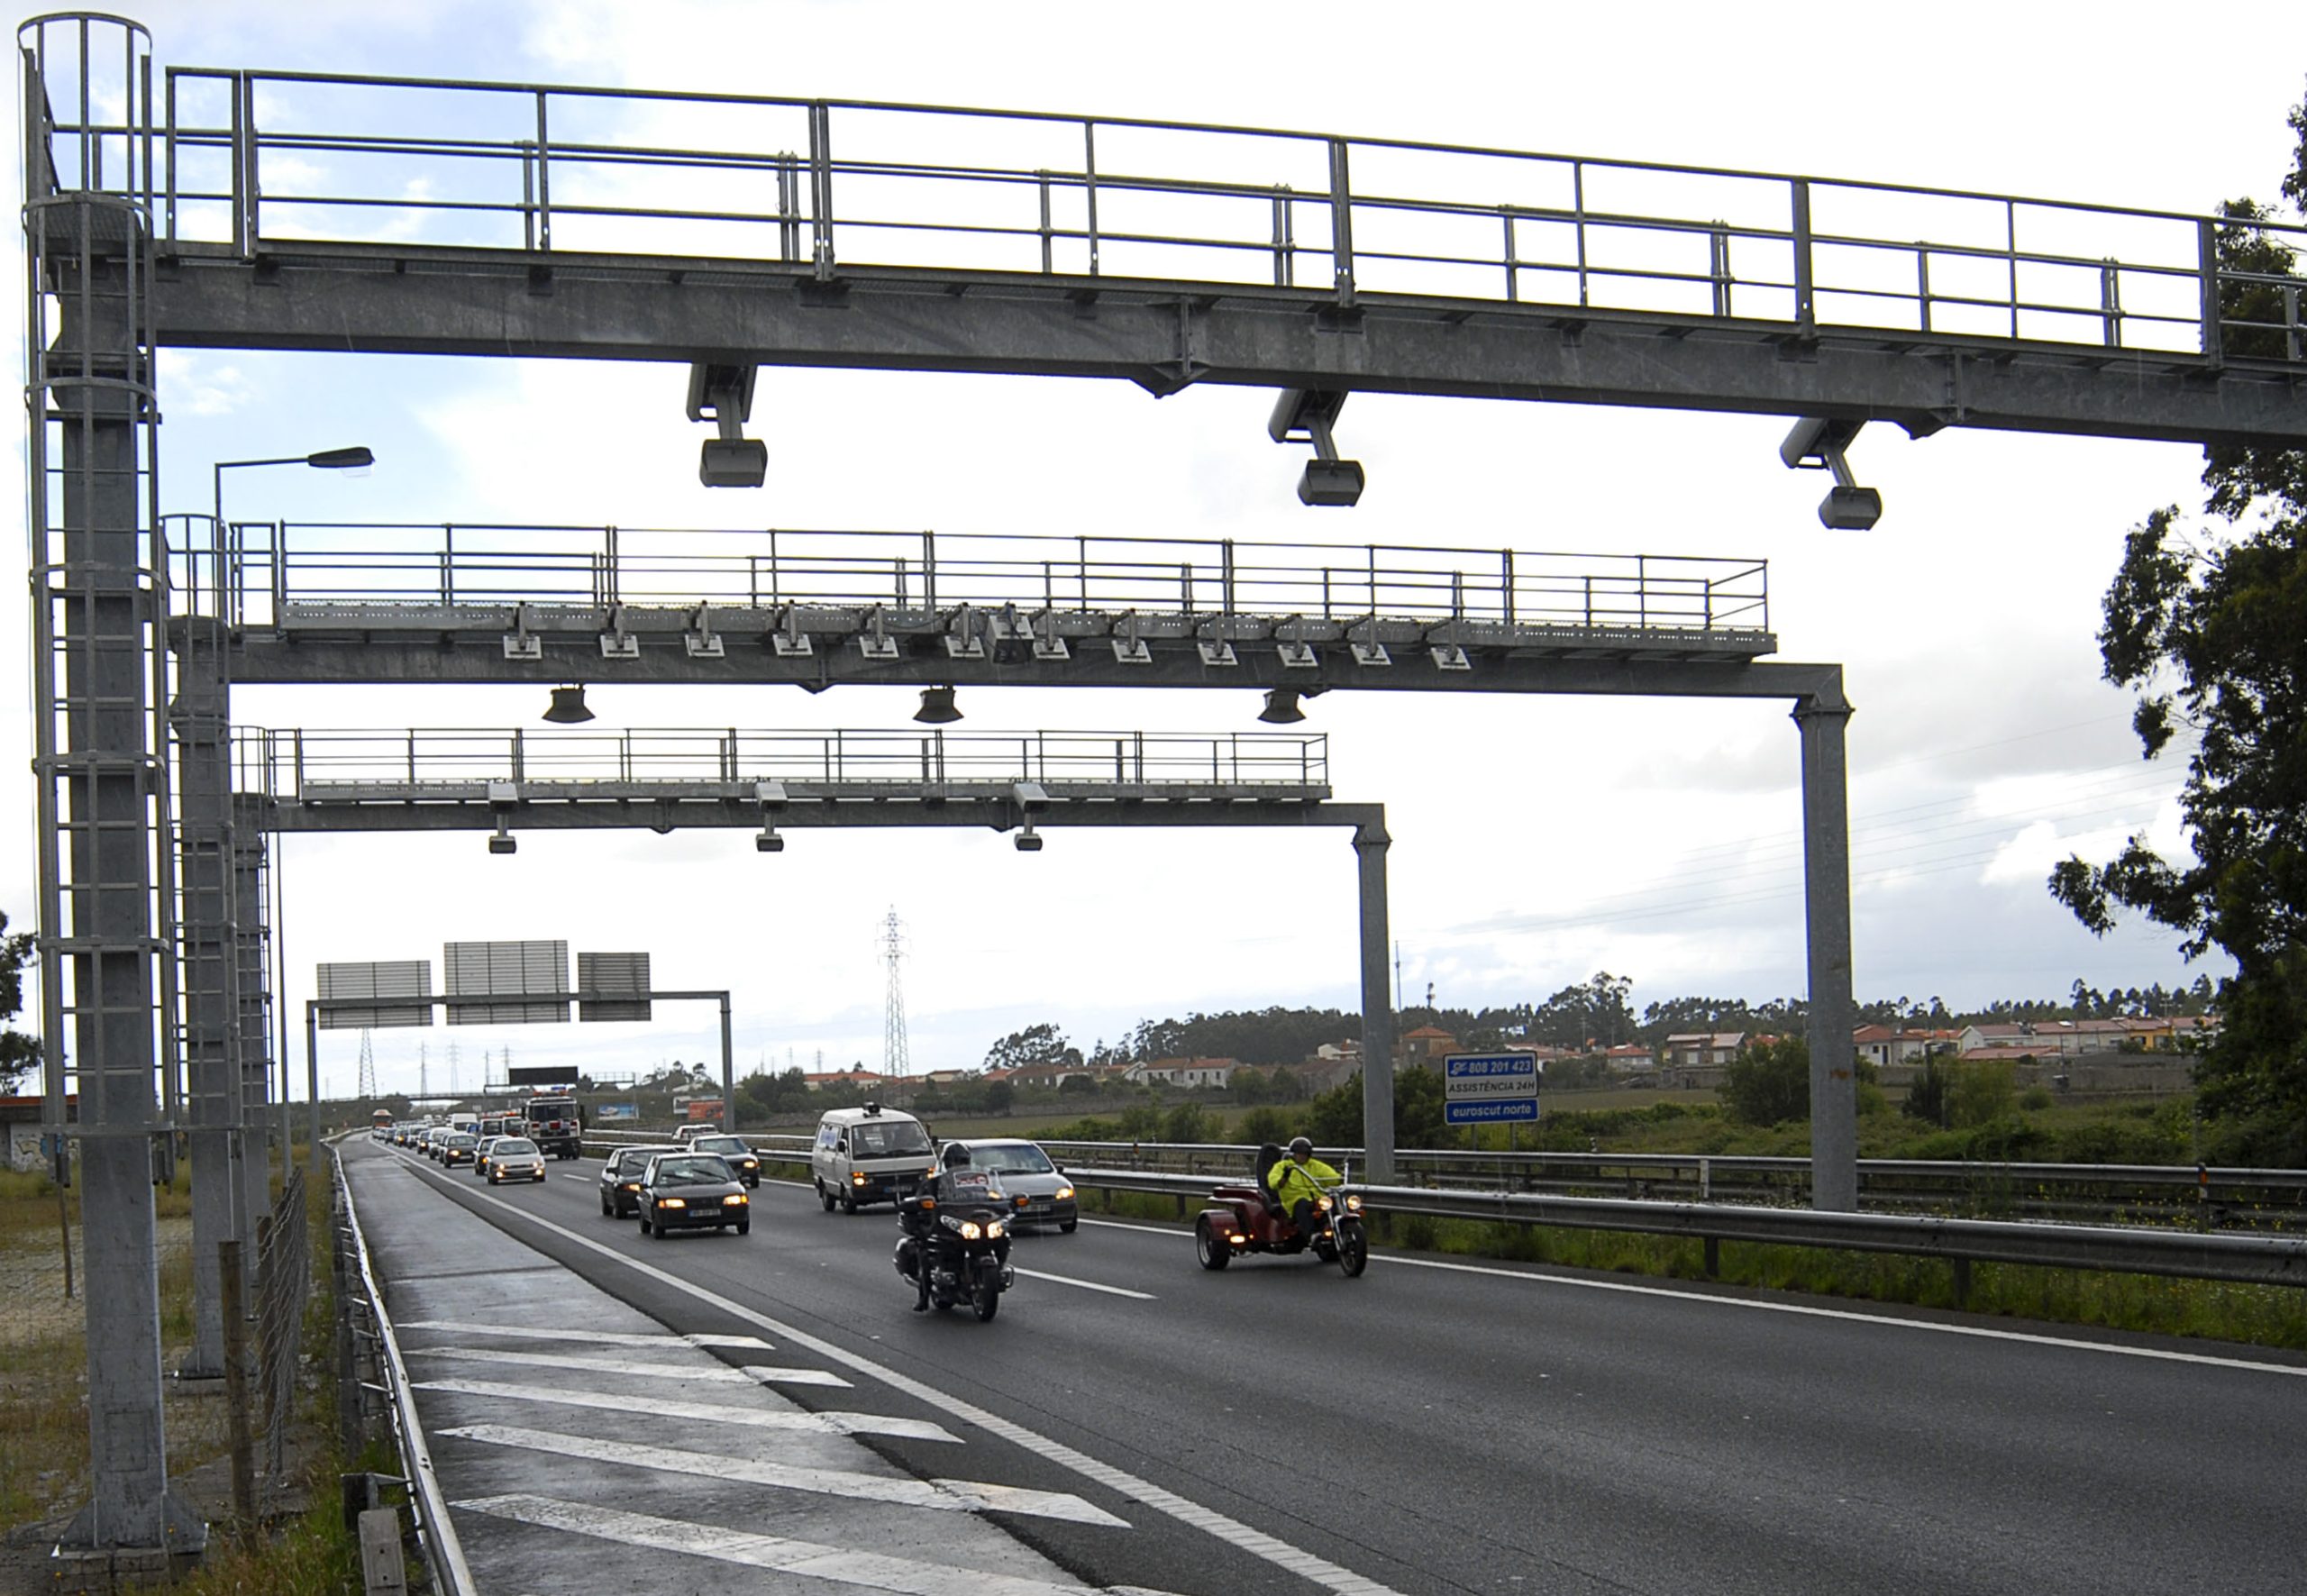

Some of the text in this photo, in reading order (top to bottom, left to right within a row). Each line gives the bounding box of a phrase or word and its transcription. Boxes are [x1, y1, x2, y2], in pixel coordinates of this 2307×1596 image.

[1469, 1061, 1531, 1073] 808 201 423
[1517, 1081, 1535, 1090] 24H
[1453, 1104, 1531, 1117] euroscut norte
